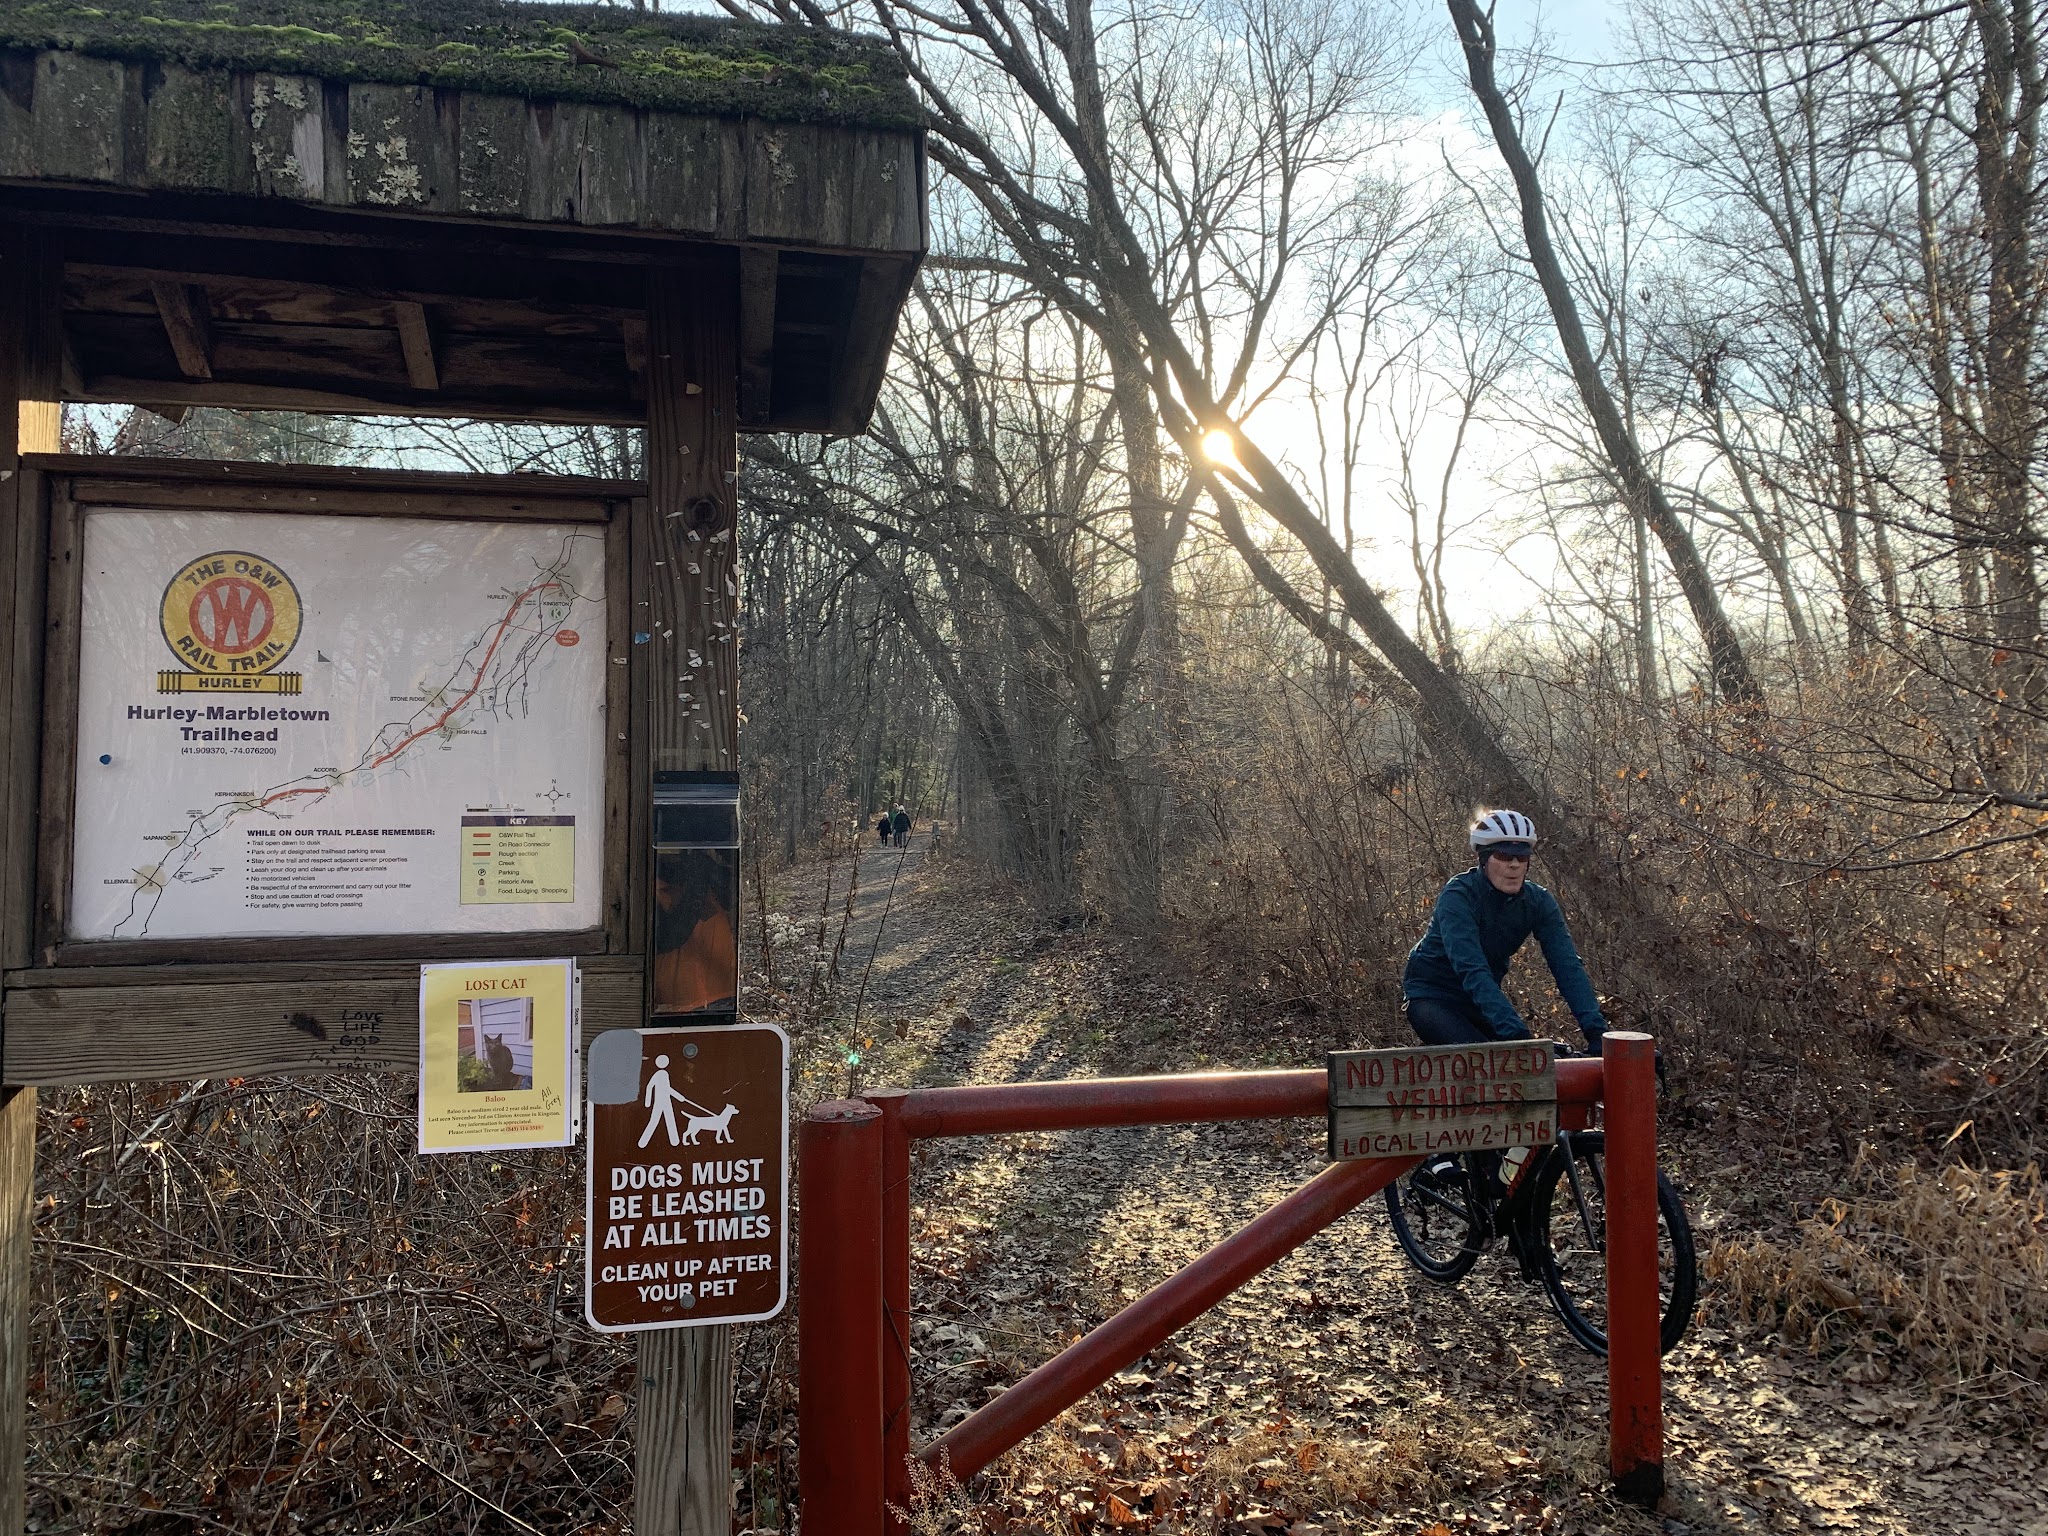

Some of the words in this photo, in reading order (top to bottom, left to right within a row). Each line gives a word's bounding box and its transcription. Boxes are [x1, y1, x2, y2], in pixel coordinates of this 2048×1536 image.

[184, 559, 225, 586] THE
[234, 560, 282, 589] O&W
[177, 635, 218, 670] RAIL
[228, 641, 284, 672] TRAIL
[199, 678, 262, 688] HURLEY
[127, 706, 330, 722] Hurley-Marbletown
[181, 728, 278, 741] Trailhead
[181, 747, 227, 756] (41.909370,
[465, 980, 498, 990] LOST
[501, 979, 527, 988] CAT
[342, 1010, 384, 1022] LOVE
[344, 1022, 381, 1033] LIFE
[340, 1035, 380, 1046] GOD
[338, 1060, 391, 1070] FRIEND
[1347, 1059, 1384, 1089] NO
[1393, 1048, 1547, 1085] MOTORIZED
[541, 1087, 551, 1101] All
[1387, 1083, 1524, 1121] VEHICLES
[1343, 1133, 1417, 1156] LOCAL
[1426, 1129, 1474, 1149] LAW
[611, 1164, 682, 1190] DOGS
[692, 1159, 764, 1185] MUST
[610, 1194, 642, 1220] BE
[652, 1188, 765, 1216] LEASHED
[603, 1224, 634, 1250] AT
[641, 1221, 686, 1246] ALL
[694, 1216, 770, 1242] TIMES
[602, 1262, 668, 1282] CLEAN
[676, 1260, 702, 1277] UP
[708, 1254, 772, 1275] AFTER
[638, 1282, 692, 1302] YOUR
[700, 1279, 737, 1298] PET
